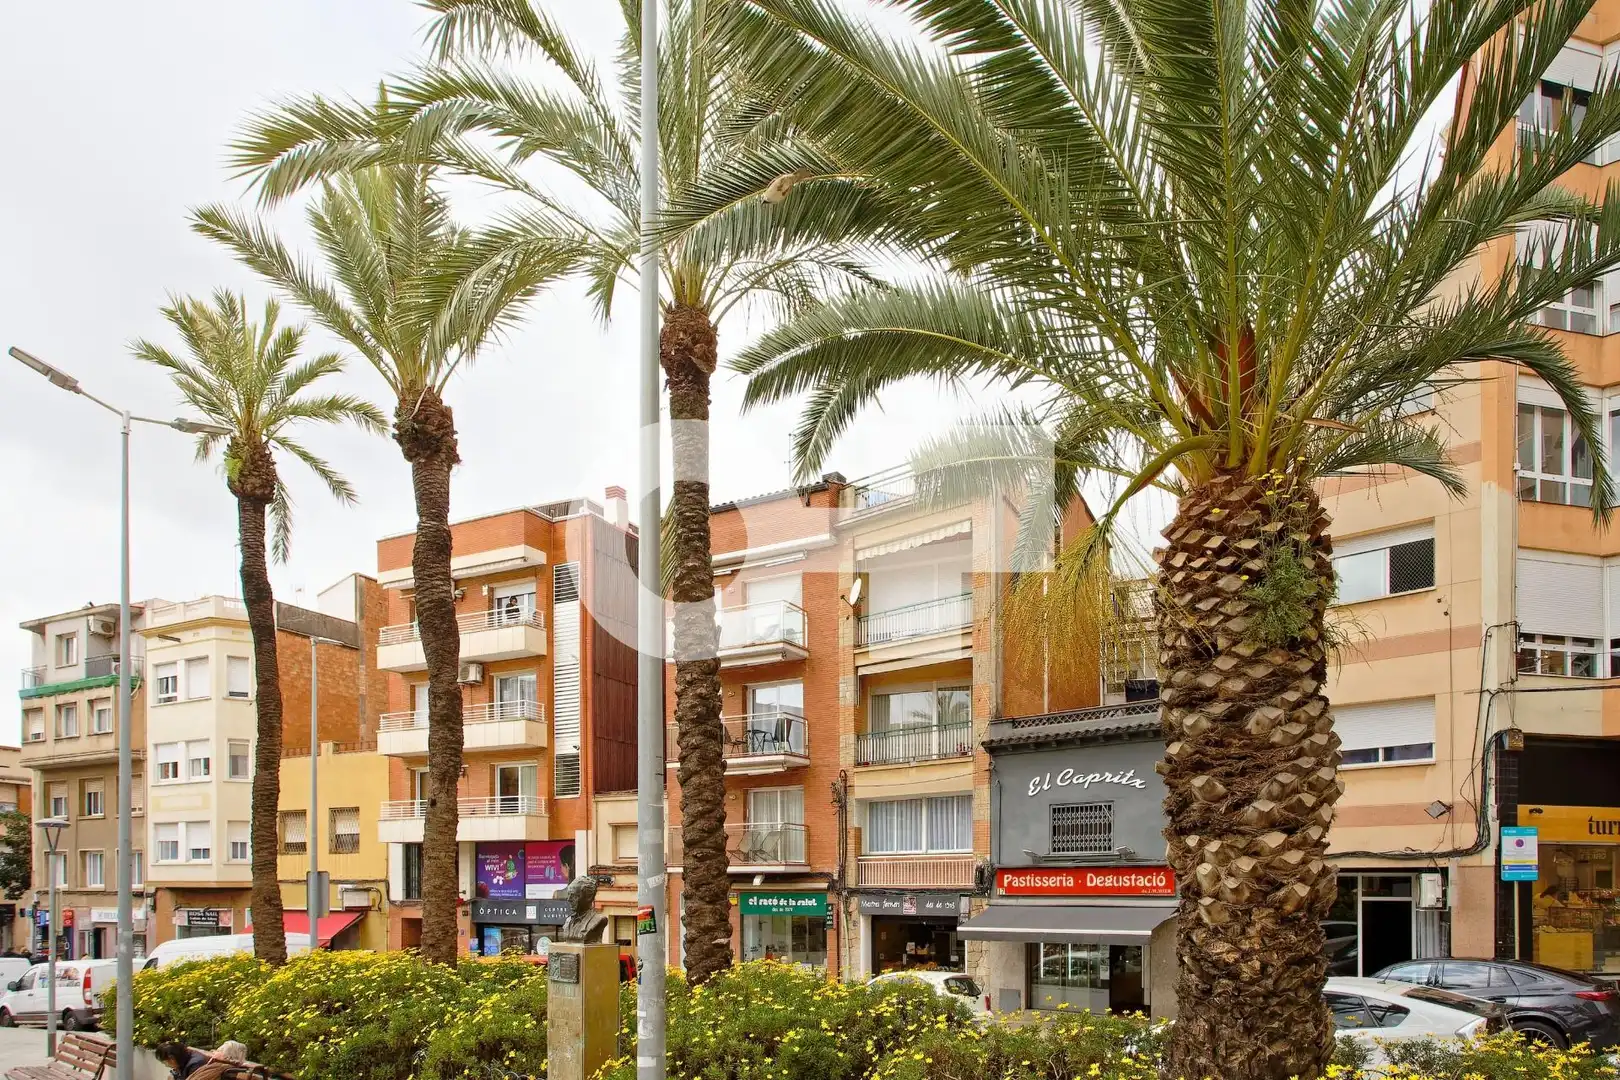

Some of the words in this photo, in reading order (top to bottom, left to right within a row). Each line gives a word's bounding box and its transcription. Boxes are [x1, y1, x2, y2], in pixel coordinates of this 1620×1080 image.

[1028, 772, 1051, 796] El
[1056, 768, 1146, 789] Capritx
[1003, 874, 1074, 887] Pastisseria
[1086, 872, 1166, 887] Degustació
[748, 896, 757, 905] el
[779, 898, 787, 906] de
[789, 898, 796, 906] la
[479, 907, 517, 915] ÒPTICA
